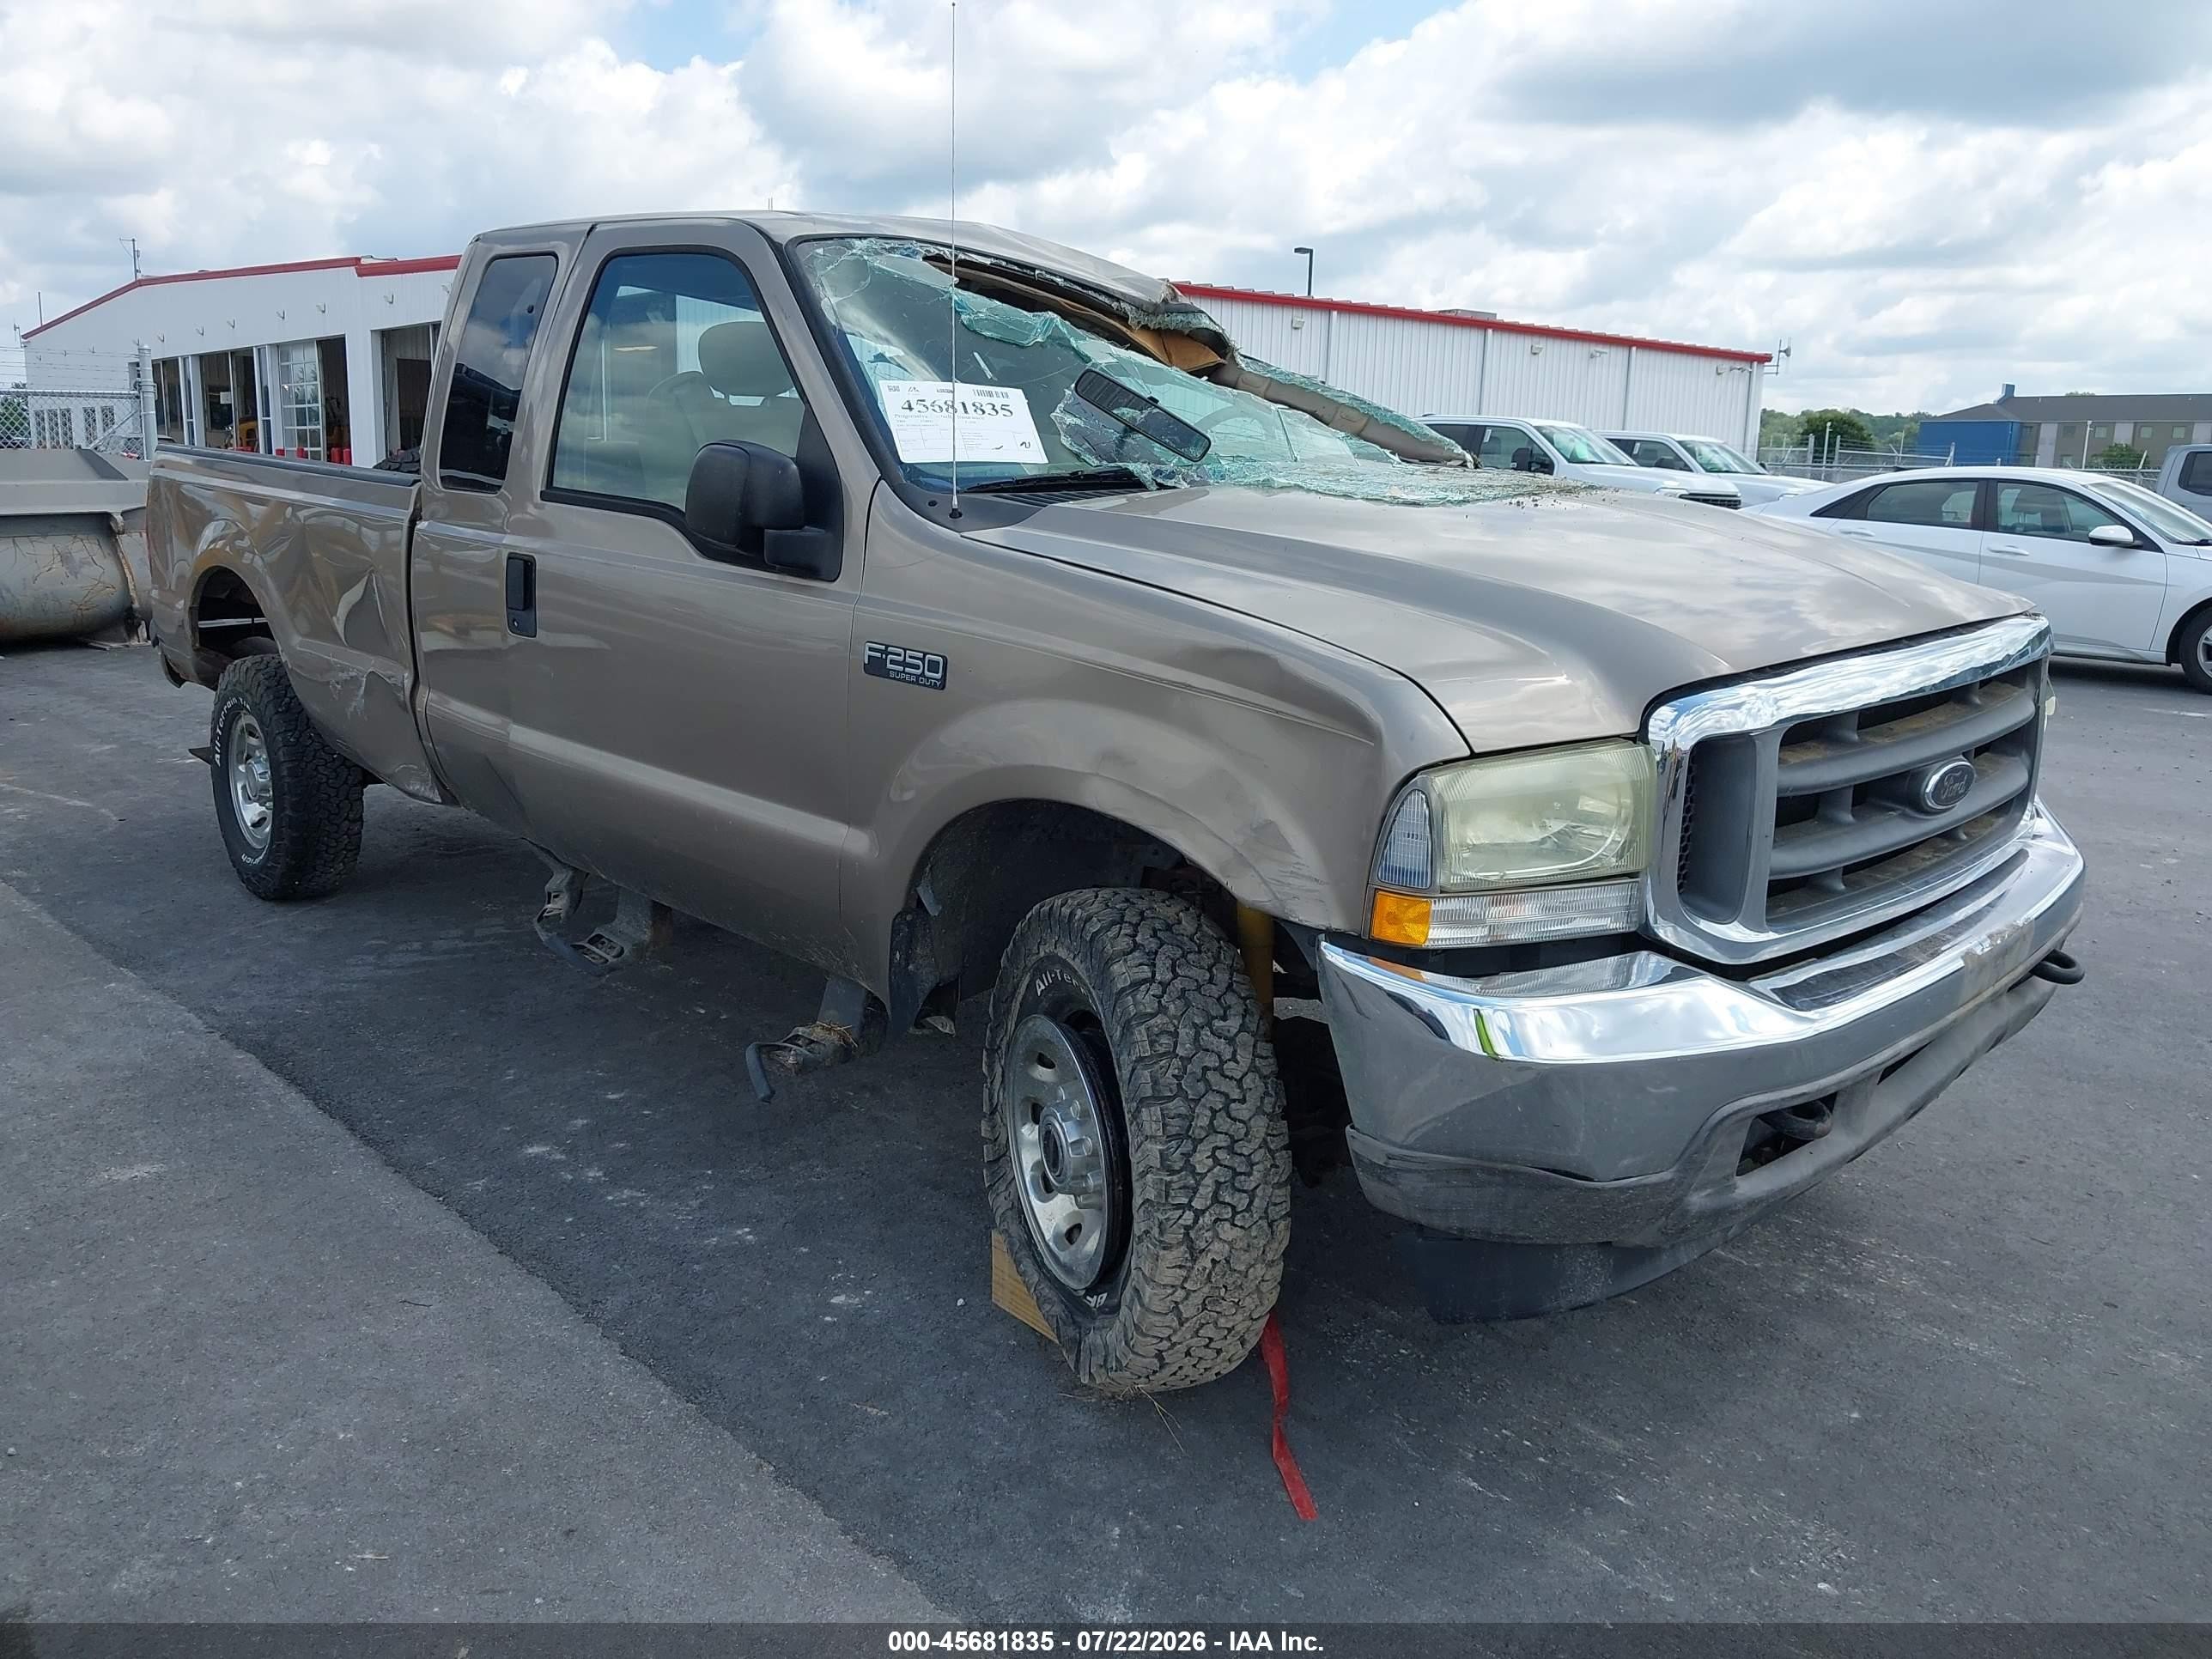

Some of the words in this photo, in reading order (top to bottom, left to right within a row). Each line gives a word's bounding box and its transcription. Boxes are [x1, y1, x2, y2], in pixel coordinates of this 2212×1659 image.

[901, 398, 1014, 418] 45681835
[889, 671, 916, 683] SUPER
[919, 677, 942, 688] DUTY
[1941, 770, 1968, 799] Ford
